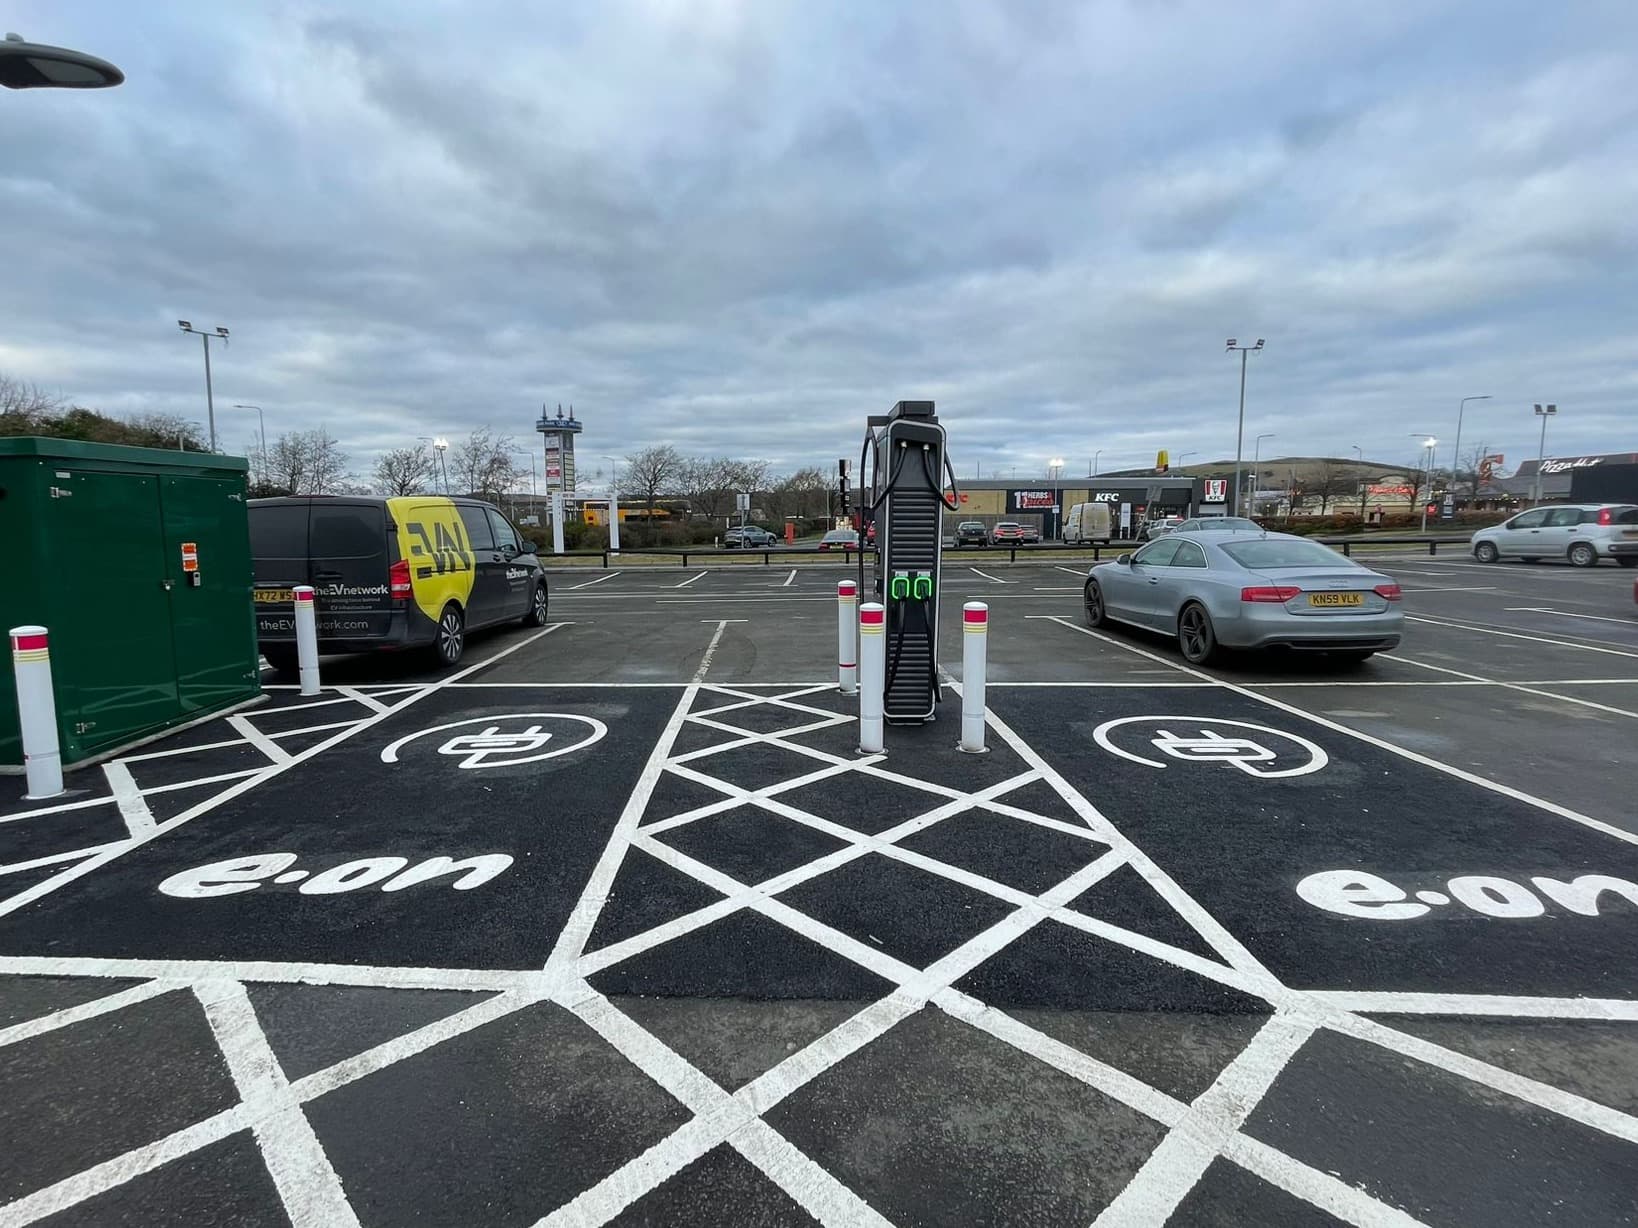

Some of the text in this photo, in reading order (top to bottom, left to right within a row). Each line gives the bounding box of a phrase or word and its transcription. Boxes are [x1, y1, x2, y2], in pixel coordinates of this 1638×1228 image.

[1027, 491, 1049, 500] HERBS
[1095, 493, 1119, 502] KFC
[1312, 594, 1360, 604] KN59 VLK
